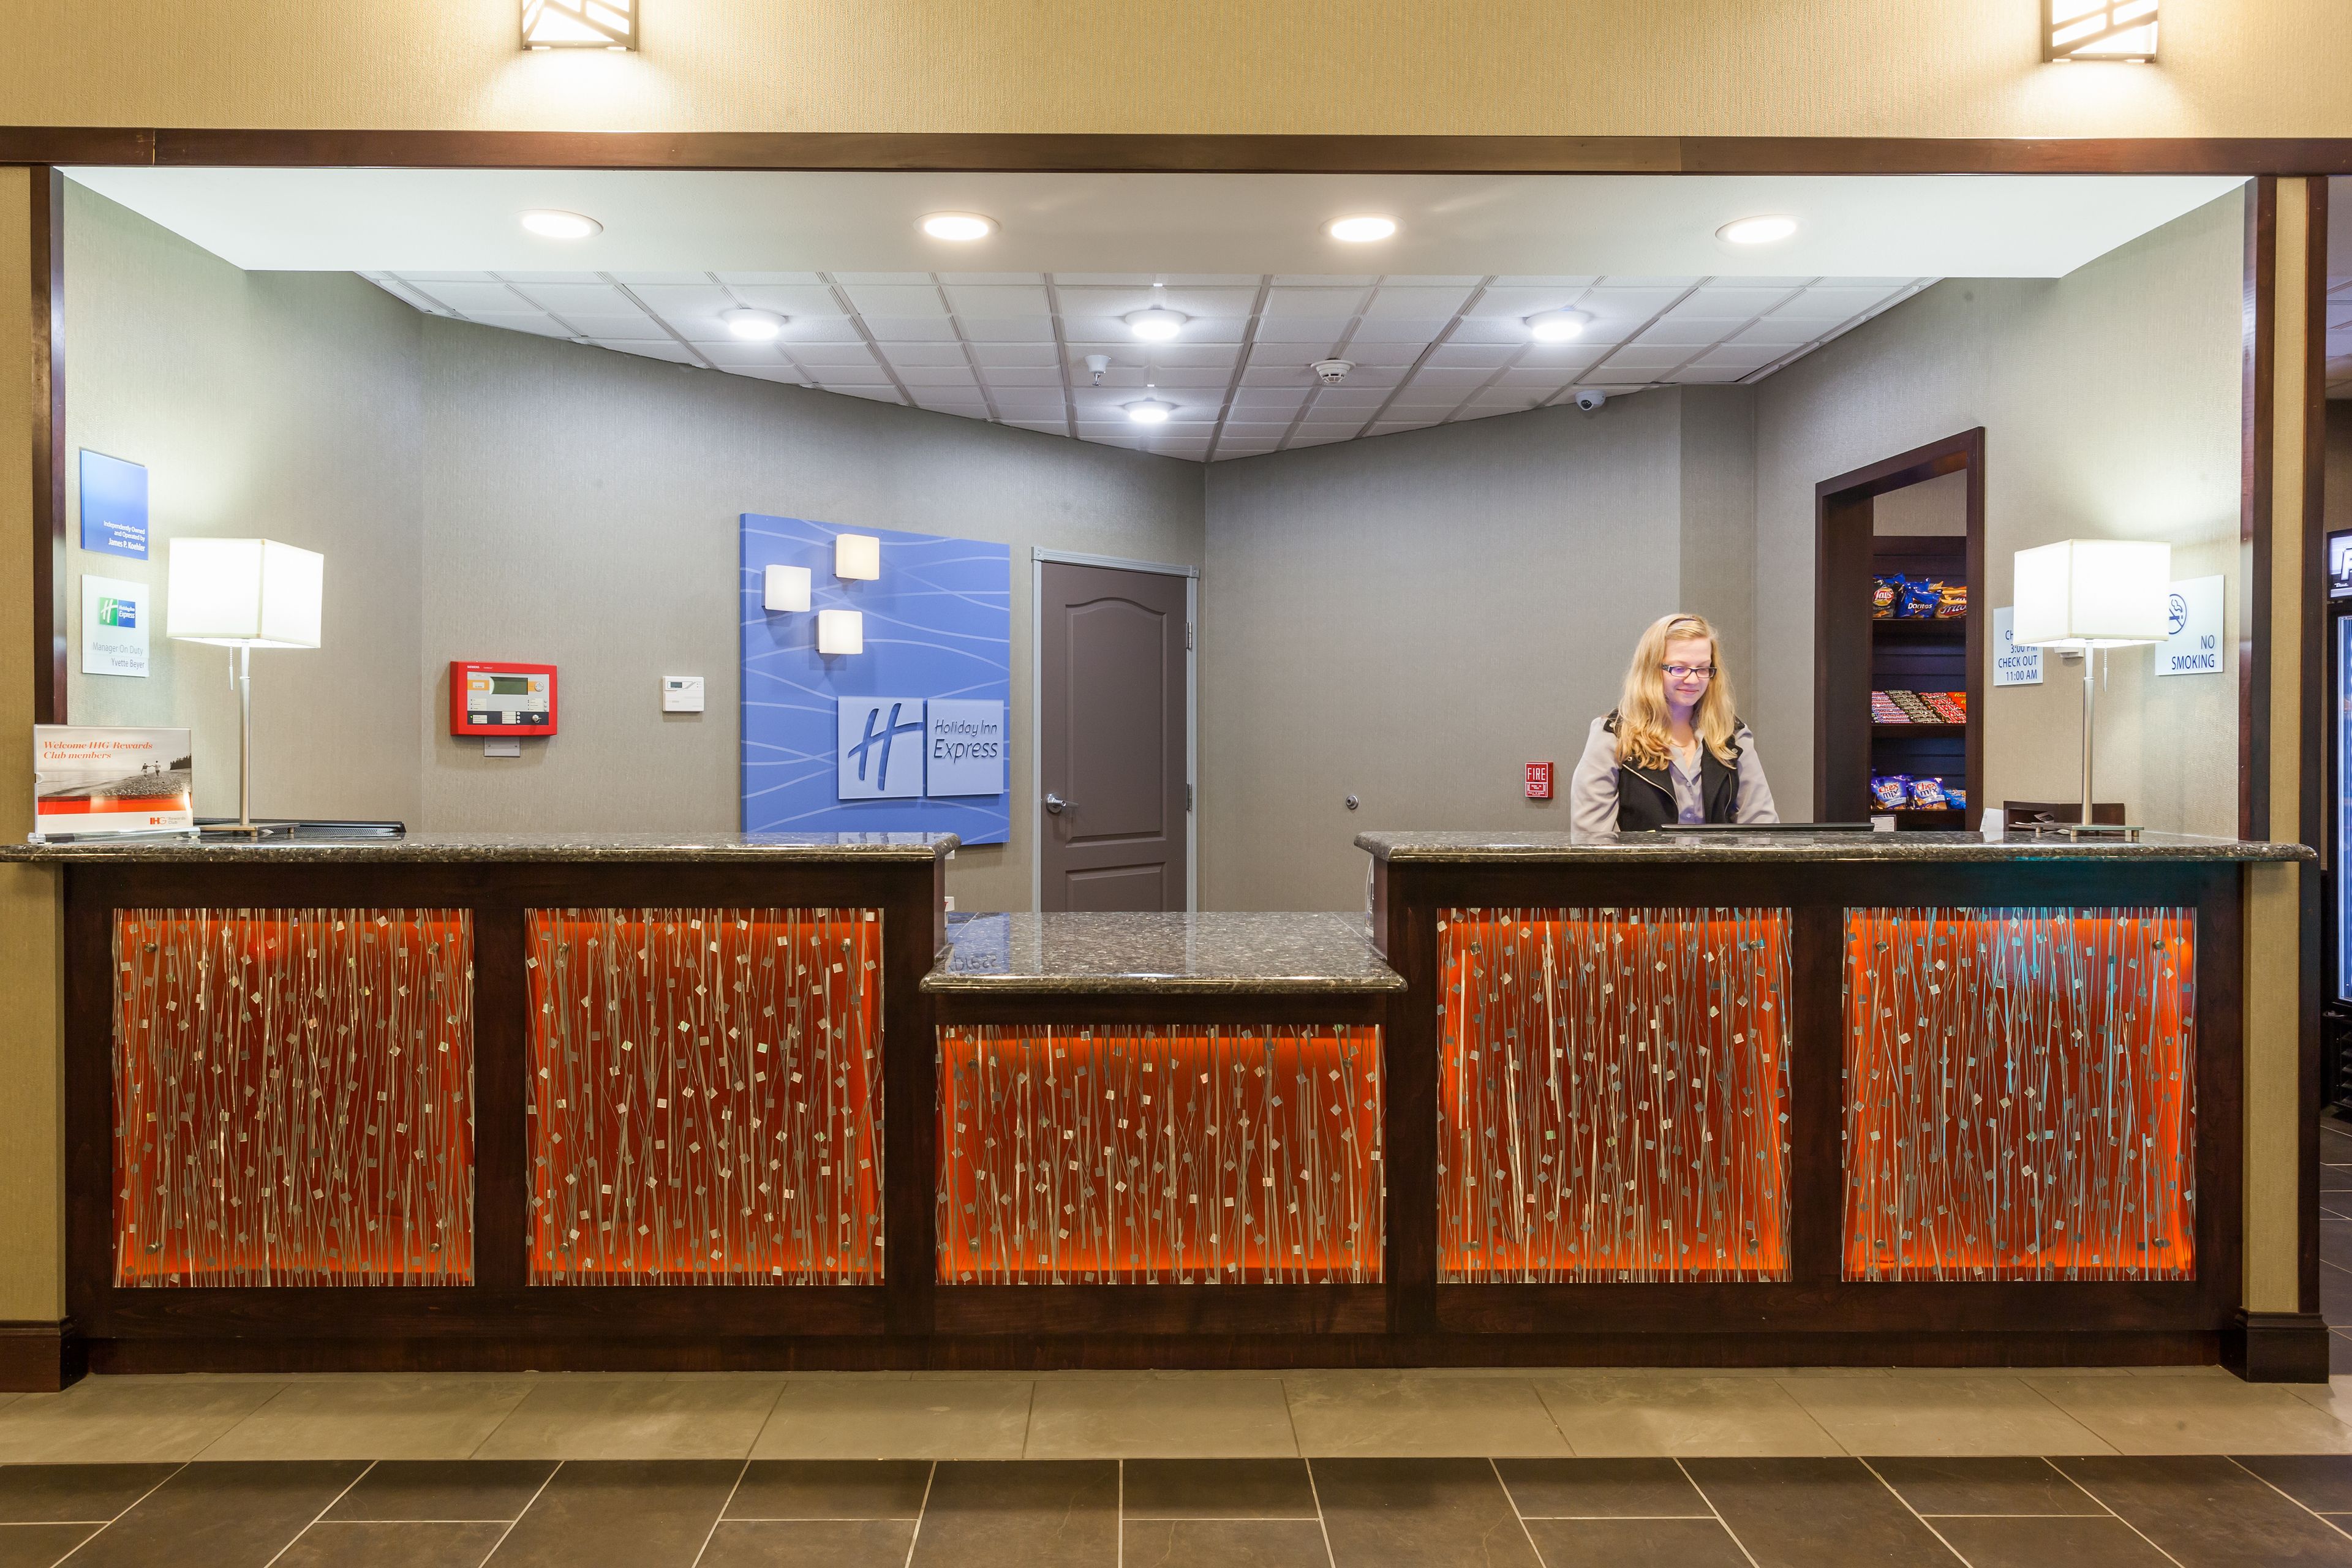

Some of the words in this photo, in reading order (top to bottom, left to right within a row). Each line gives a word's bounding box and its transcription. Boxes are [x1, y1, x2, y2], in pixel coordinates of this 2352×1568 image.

[104, 521, 130, 532] Independently
[108, 538, 123, 547] James
[128, 541, 145, 551] Koehler
[1940, 604, 1967, 614] Frito
[2201, 635, 2215, 649] NO
[92, 641, 118, 654] Manager
[119, 644, 128, 654] On
[130, 645, 143, 657] Duty
[2011, 644, 2025, 654] 3:00
[111, 658, 129, 667] Yvette
[130, 659, 145, 669] Beyer
[1998, 656, 2021, 668] CHECK
[2022, 655, 2037, 666] OUT
[2171, 654, 2215, 670] SMOKING
[2006, 671, 2024, 681] 11:00
[2026, 669, 2037, 680] AM
[935, 719, 978, 736] Holiday
[980, 720, 997, 734] Inn
[933, 739, 998, 763] Express
[1528, 768, 1545, 780] FIRE
[1879, 783, 1899, 793] Chex
[1883, 788, 1899, 799] mix
